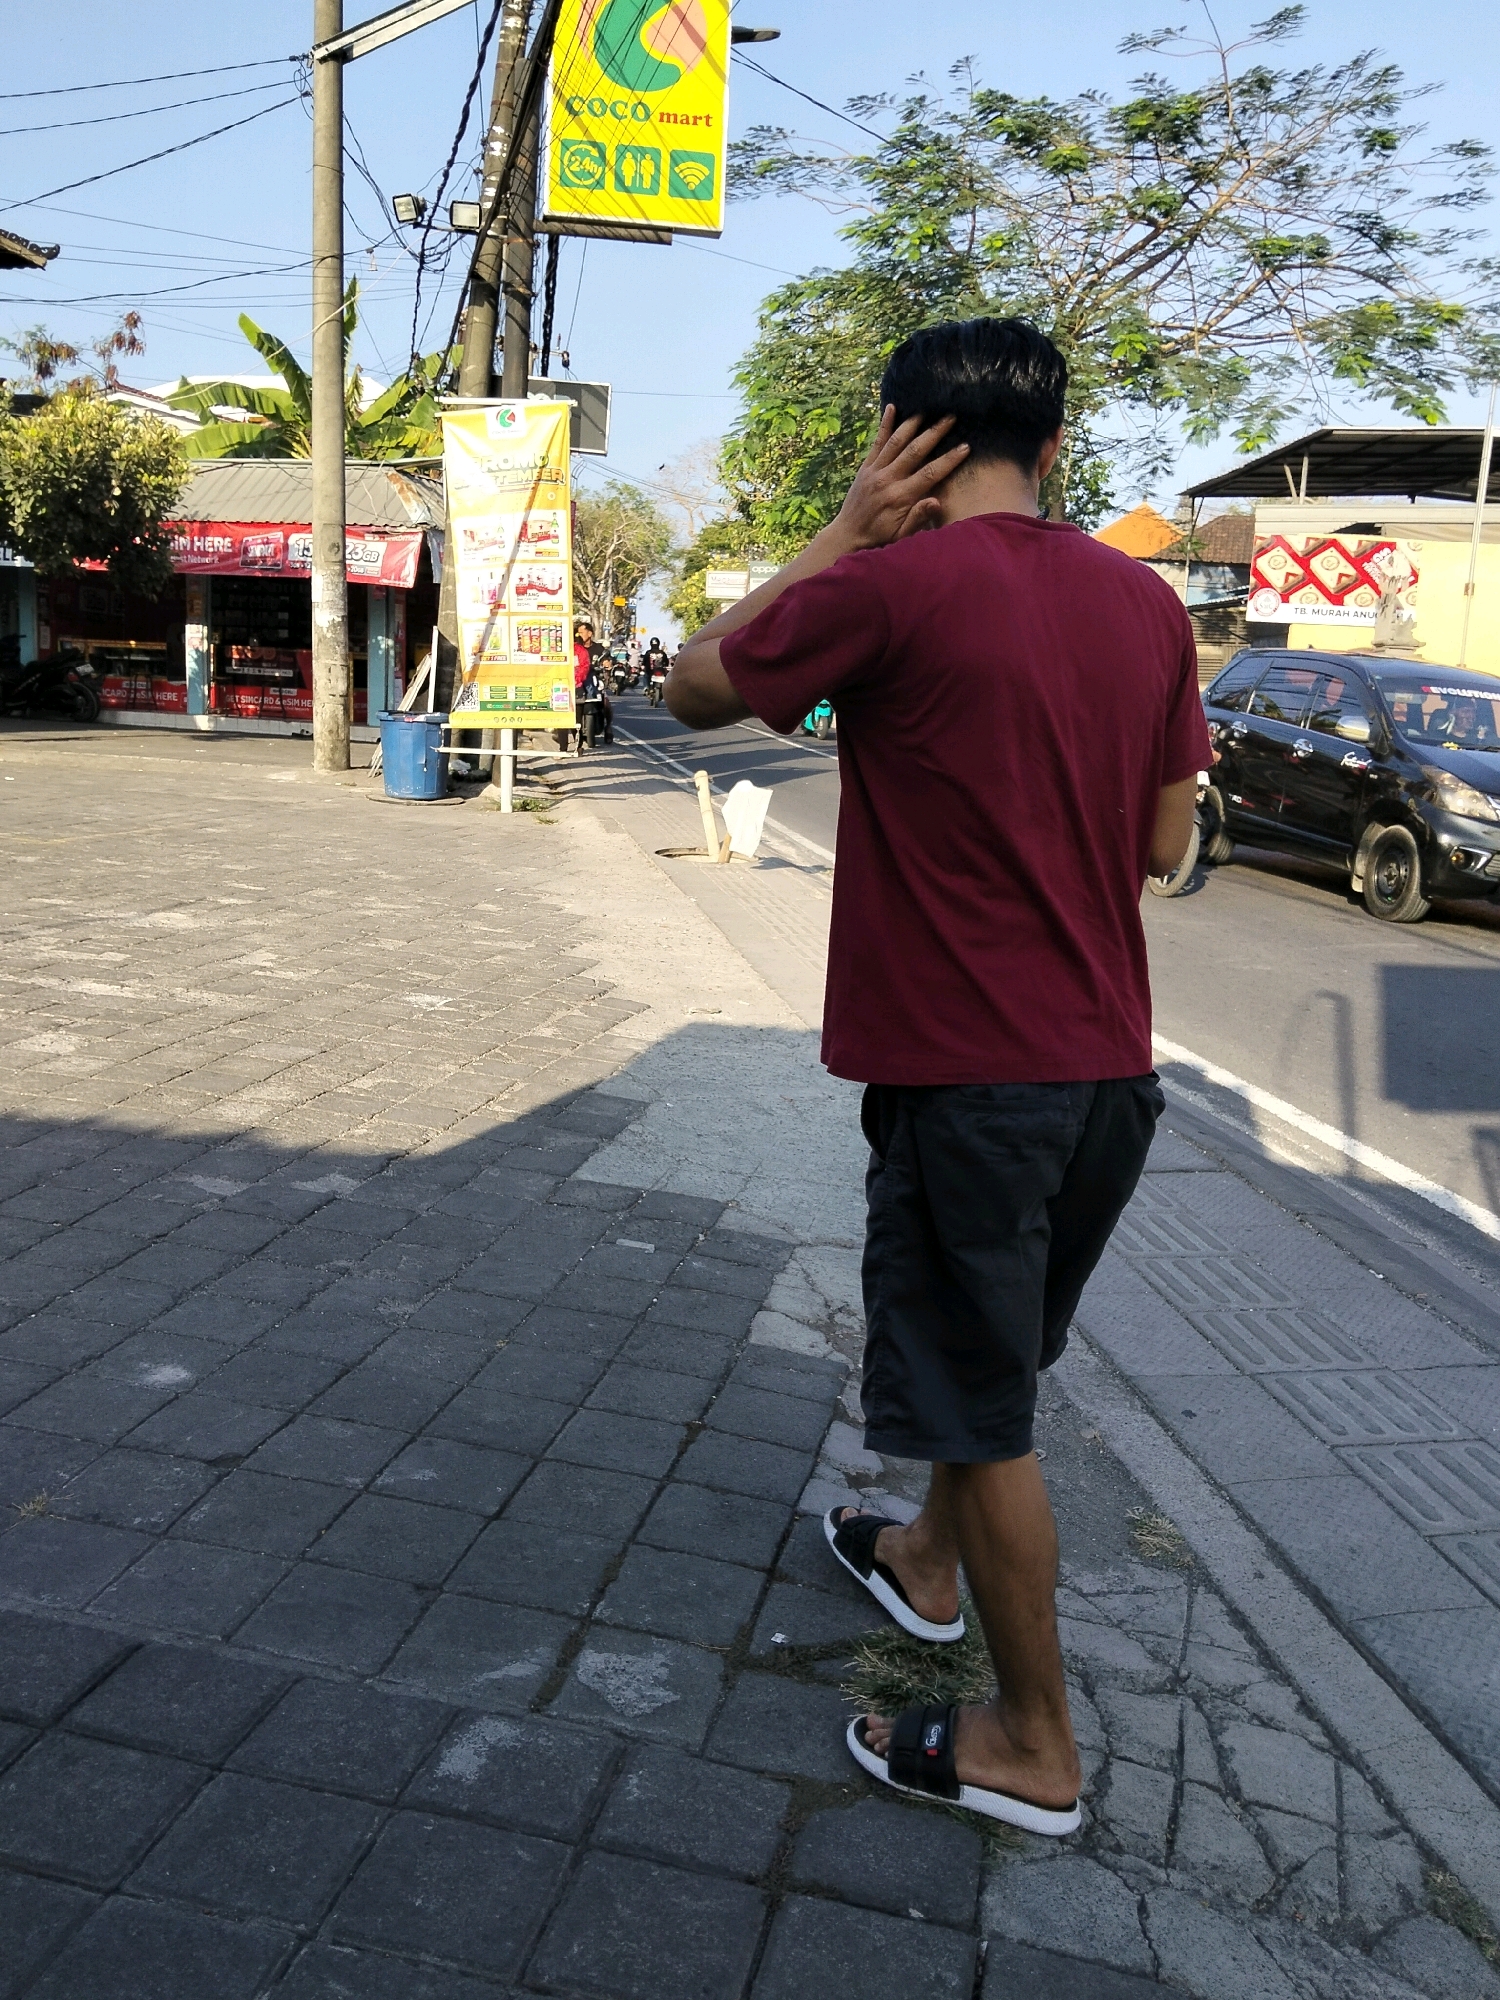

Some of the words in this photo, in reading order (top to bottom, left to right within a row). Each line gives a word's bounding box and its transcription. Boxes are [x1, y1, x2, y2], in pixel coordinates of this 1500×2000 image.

[658, 109, 714, 127] mart
[193, 536, 233, 553] HERE
[1312, 608, 1350, 618] MURAH
[156, 692, 178, 702] HERE
